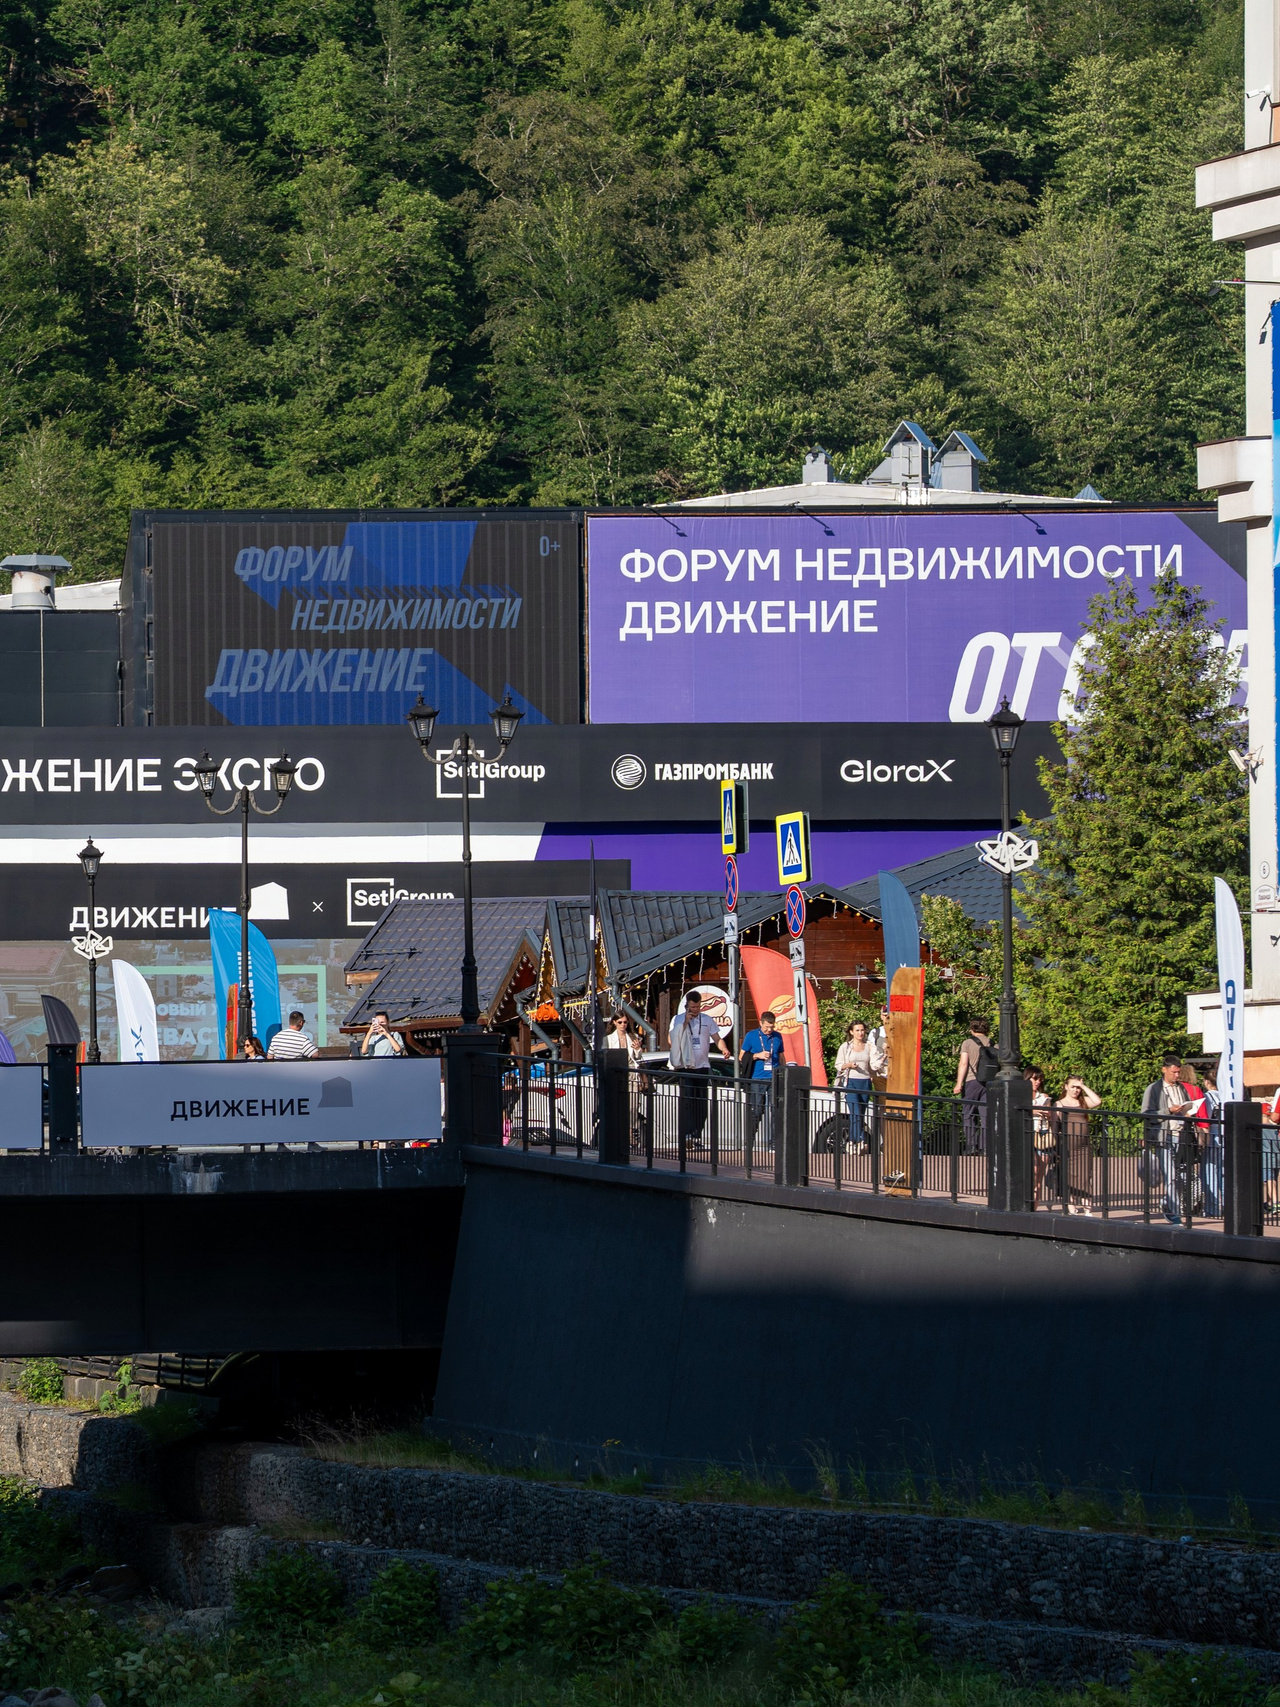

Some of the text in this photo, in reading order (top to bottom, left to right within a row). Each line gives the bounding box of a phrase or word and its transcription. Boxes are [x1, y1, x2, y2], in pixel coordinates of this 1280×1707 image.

[235, 546, 353, 581] ФОРУМ
[540, 536, 561, 557] 0+
[620, 545, 1183, 588] ФОРУМ НЕДВИЖИМОСТИ
[291, 598, 522, 633] НЕДВИЖИМОСТИ
[620, 600, 878, 641] ДВИЖЕНИЕ
[205, 648, 433, 697] ДВИЖЕНИЕ
[949, 632, 1062, 723] ОТ
[654, 762, 774, 782] ГАЗПРОМБАНК
[840, 759, 956, 783] GloraX
[170, 1097, 310, 1121] ДВИЖЕНИЕ
